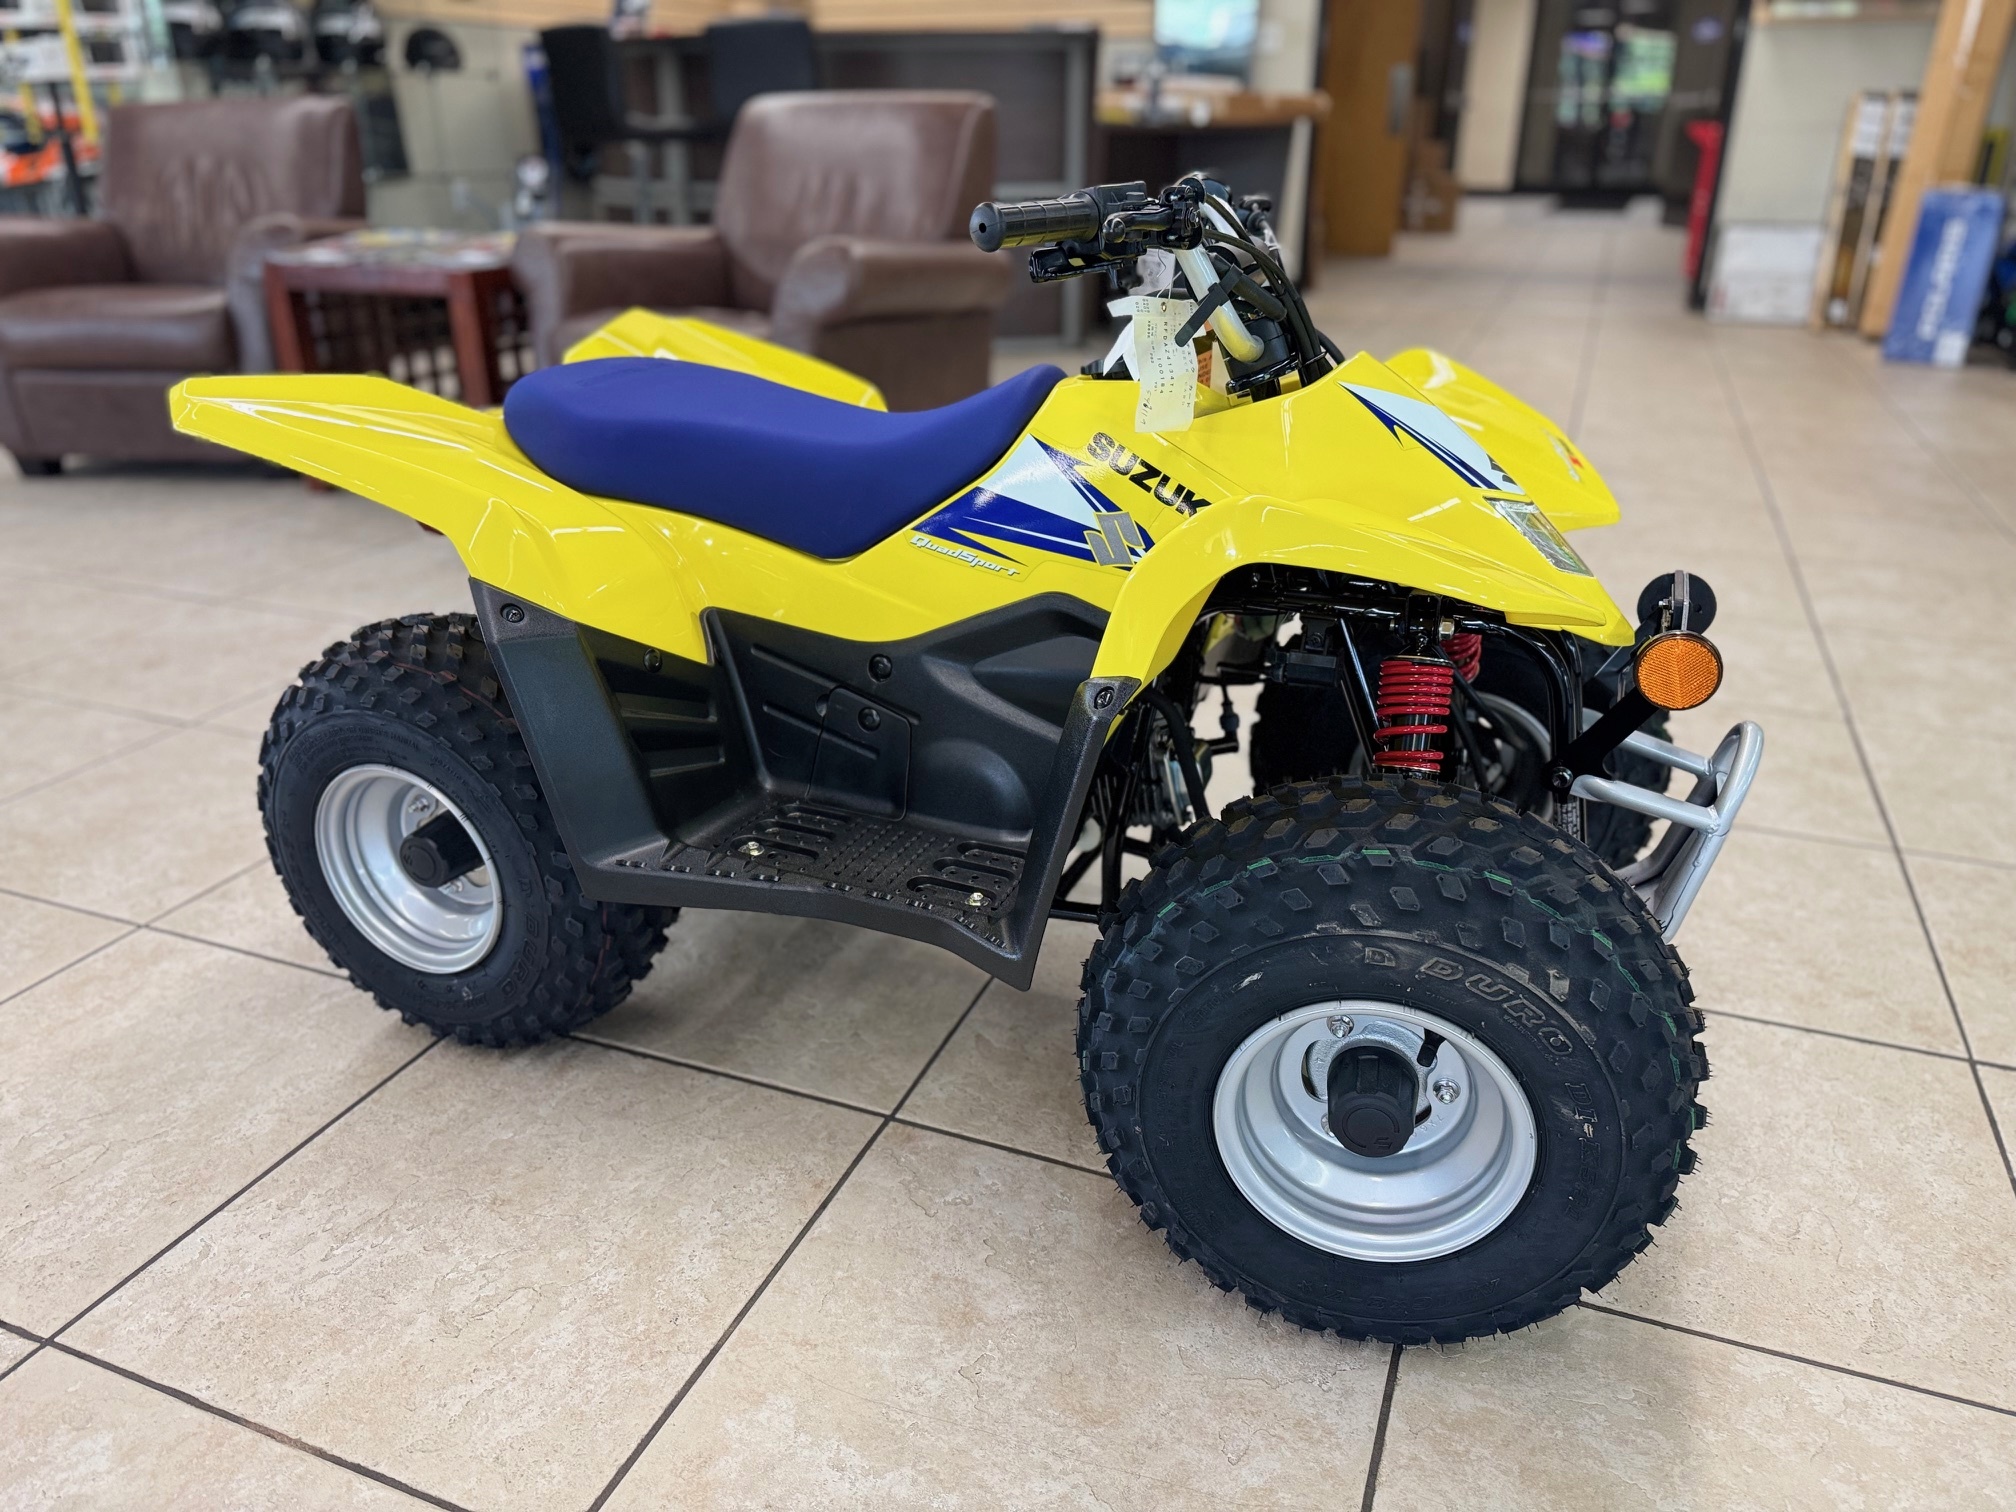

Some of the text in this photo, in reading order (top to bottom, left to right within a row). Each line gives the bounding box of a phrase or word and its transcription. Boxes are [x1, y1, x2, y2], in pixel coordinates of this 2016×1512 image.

[1087, 431, 1213, 518] SUZUK
[909, 535, 1020, 578] QuadSport
[1418, 957, 1574, 1056] DURO
